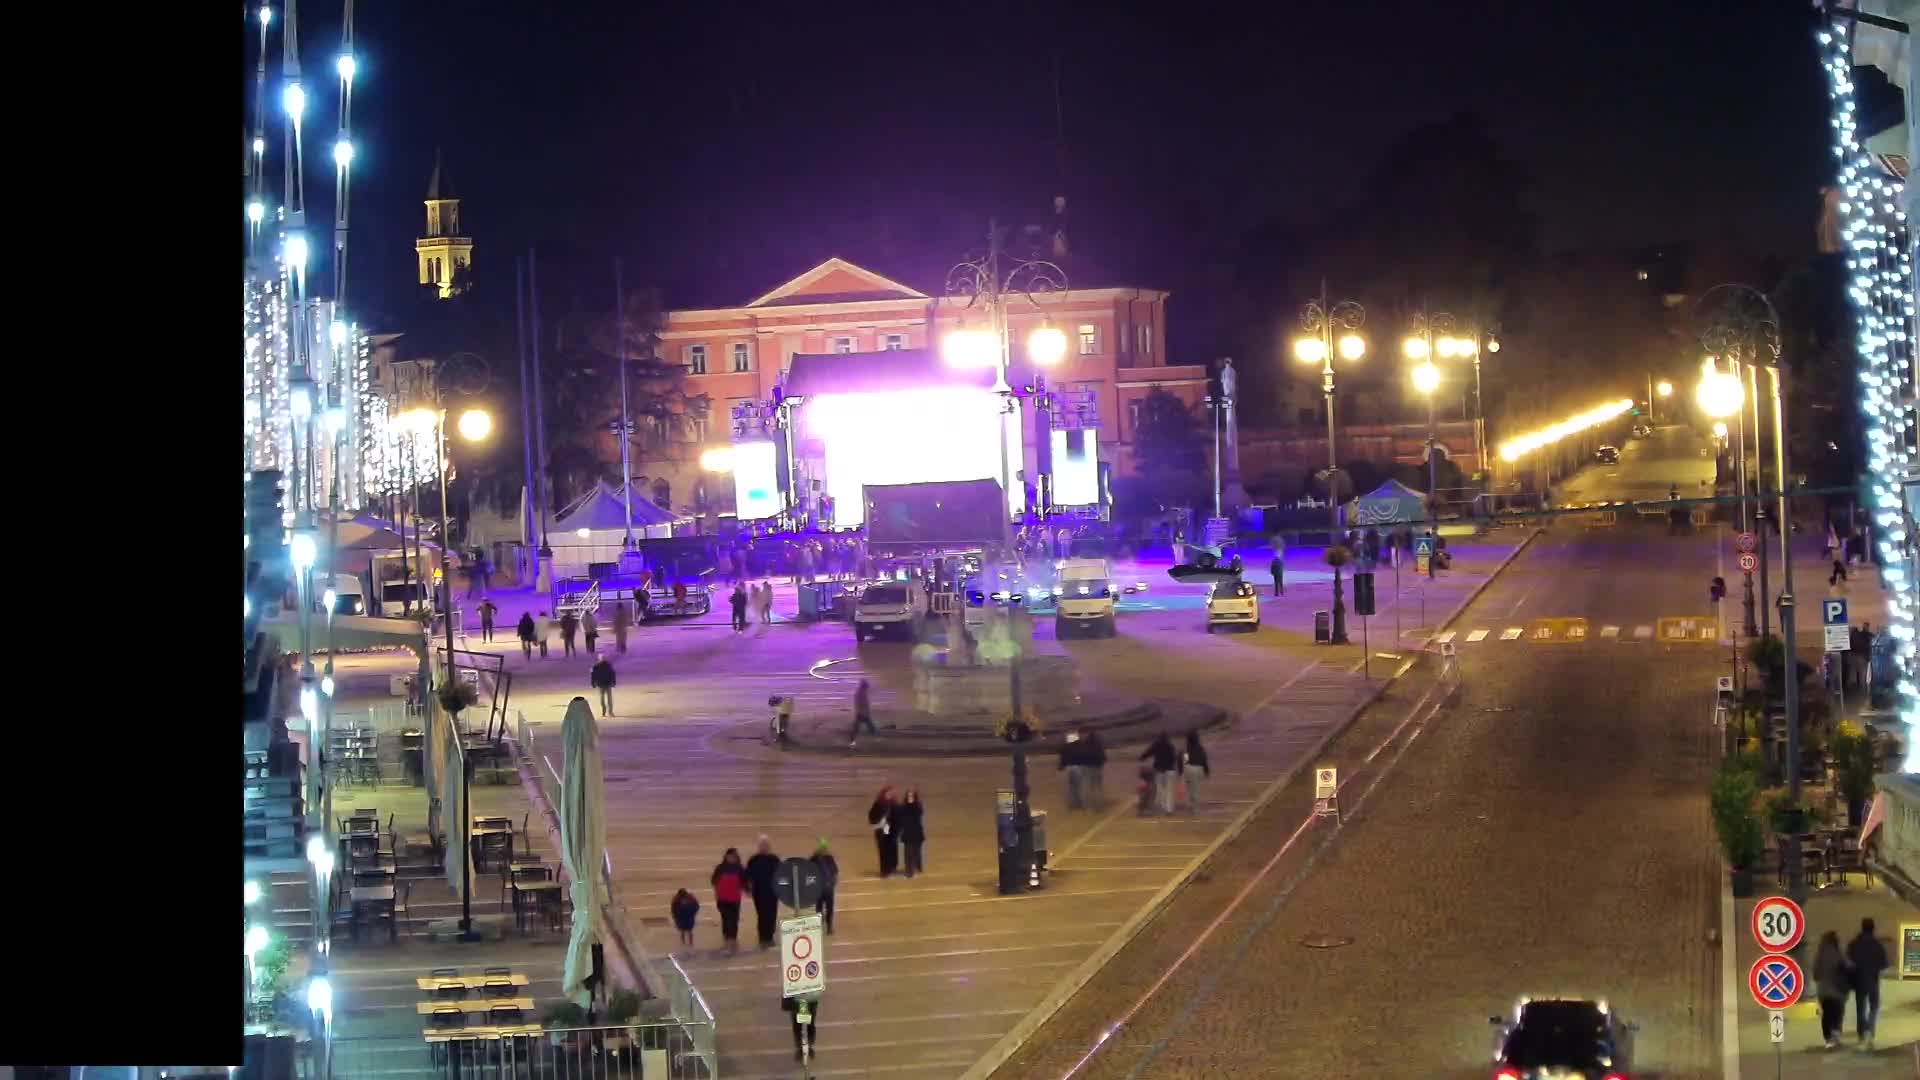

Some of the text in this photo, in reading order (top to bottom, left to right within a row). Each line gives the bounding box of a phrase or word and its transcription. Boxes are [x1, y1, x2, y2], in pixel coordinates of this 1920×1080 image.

[1742, 557, 1753, 567] 20
[1827, 601, 1843, 622] P
[1762, 912, 1792, 937] 30
